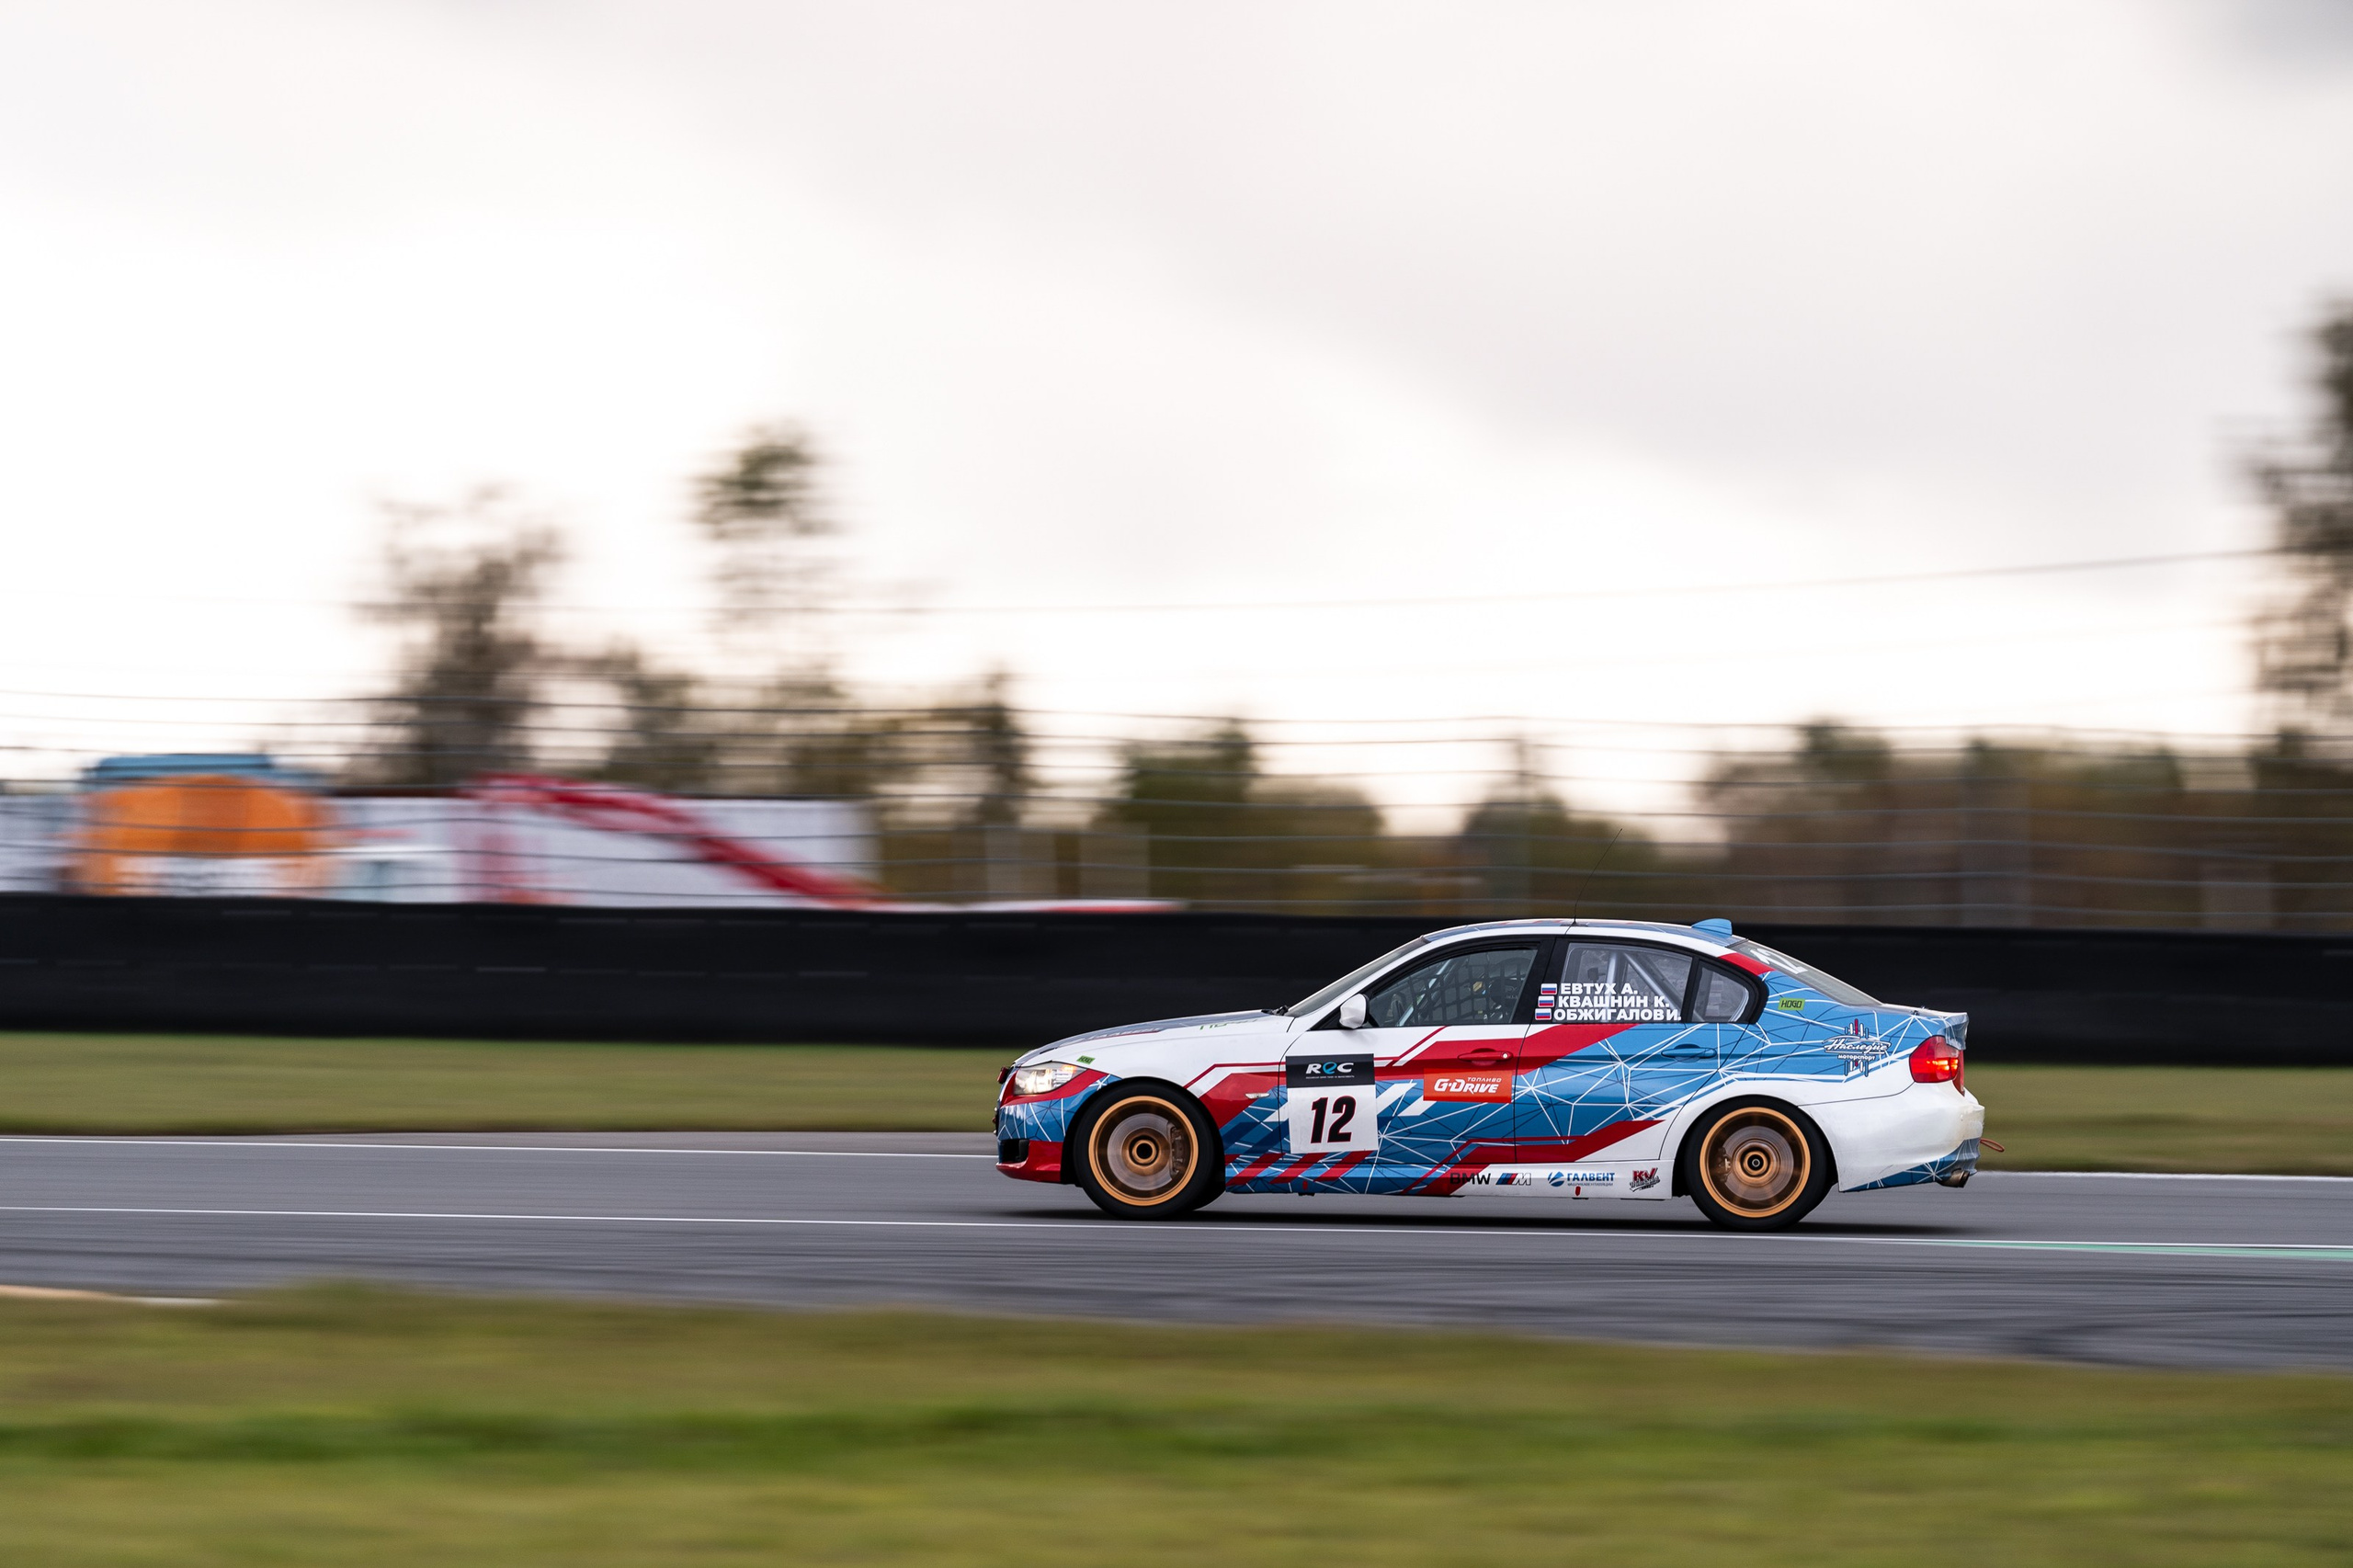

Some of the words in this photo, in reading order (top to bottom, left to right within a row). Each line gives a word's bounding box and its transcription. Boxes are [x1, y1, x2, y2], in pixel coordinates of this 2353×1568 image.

[1560, 983, 1616, 994] ЕВТУХ
[1620, 983, 1638, 994] А.
[1558, 995, 1648, 1007] КВАШНИН
[1654, 995, 1670, 1007] К.
[1553, 1008, 1665, 1021] ОБЖИГАЛОВ
[1665, 1009, 1682, 1021] И.
[1310, 1095, 1357, 1143] 12
[1449, 1173, 1491, 1186] BMW
[1566, 1172, 1616, 1182] ГАЛВЕНТ
